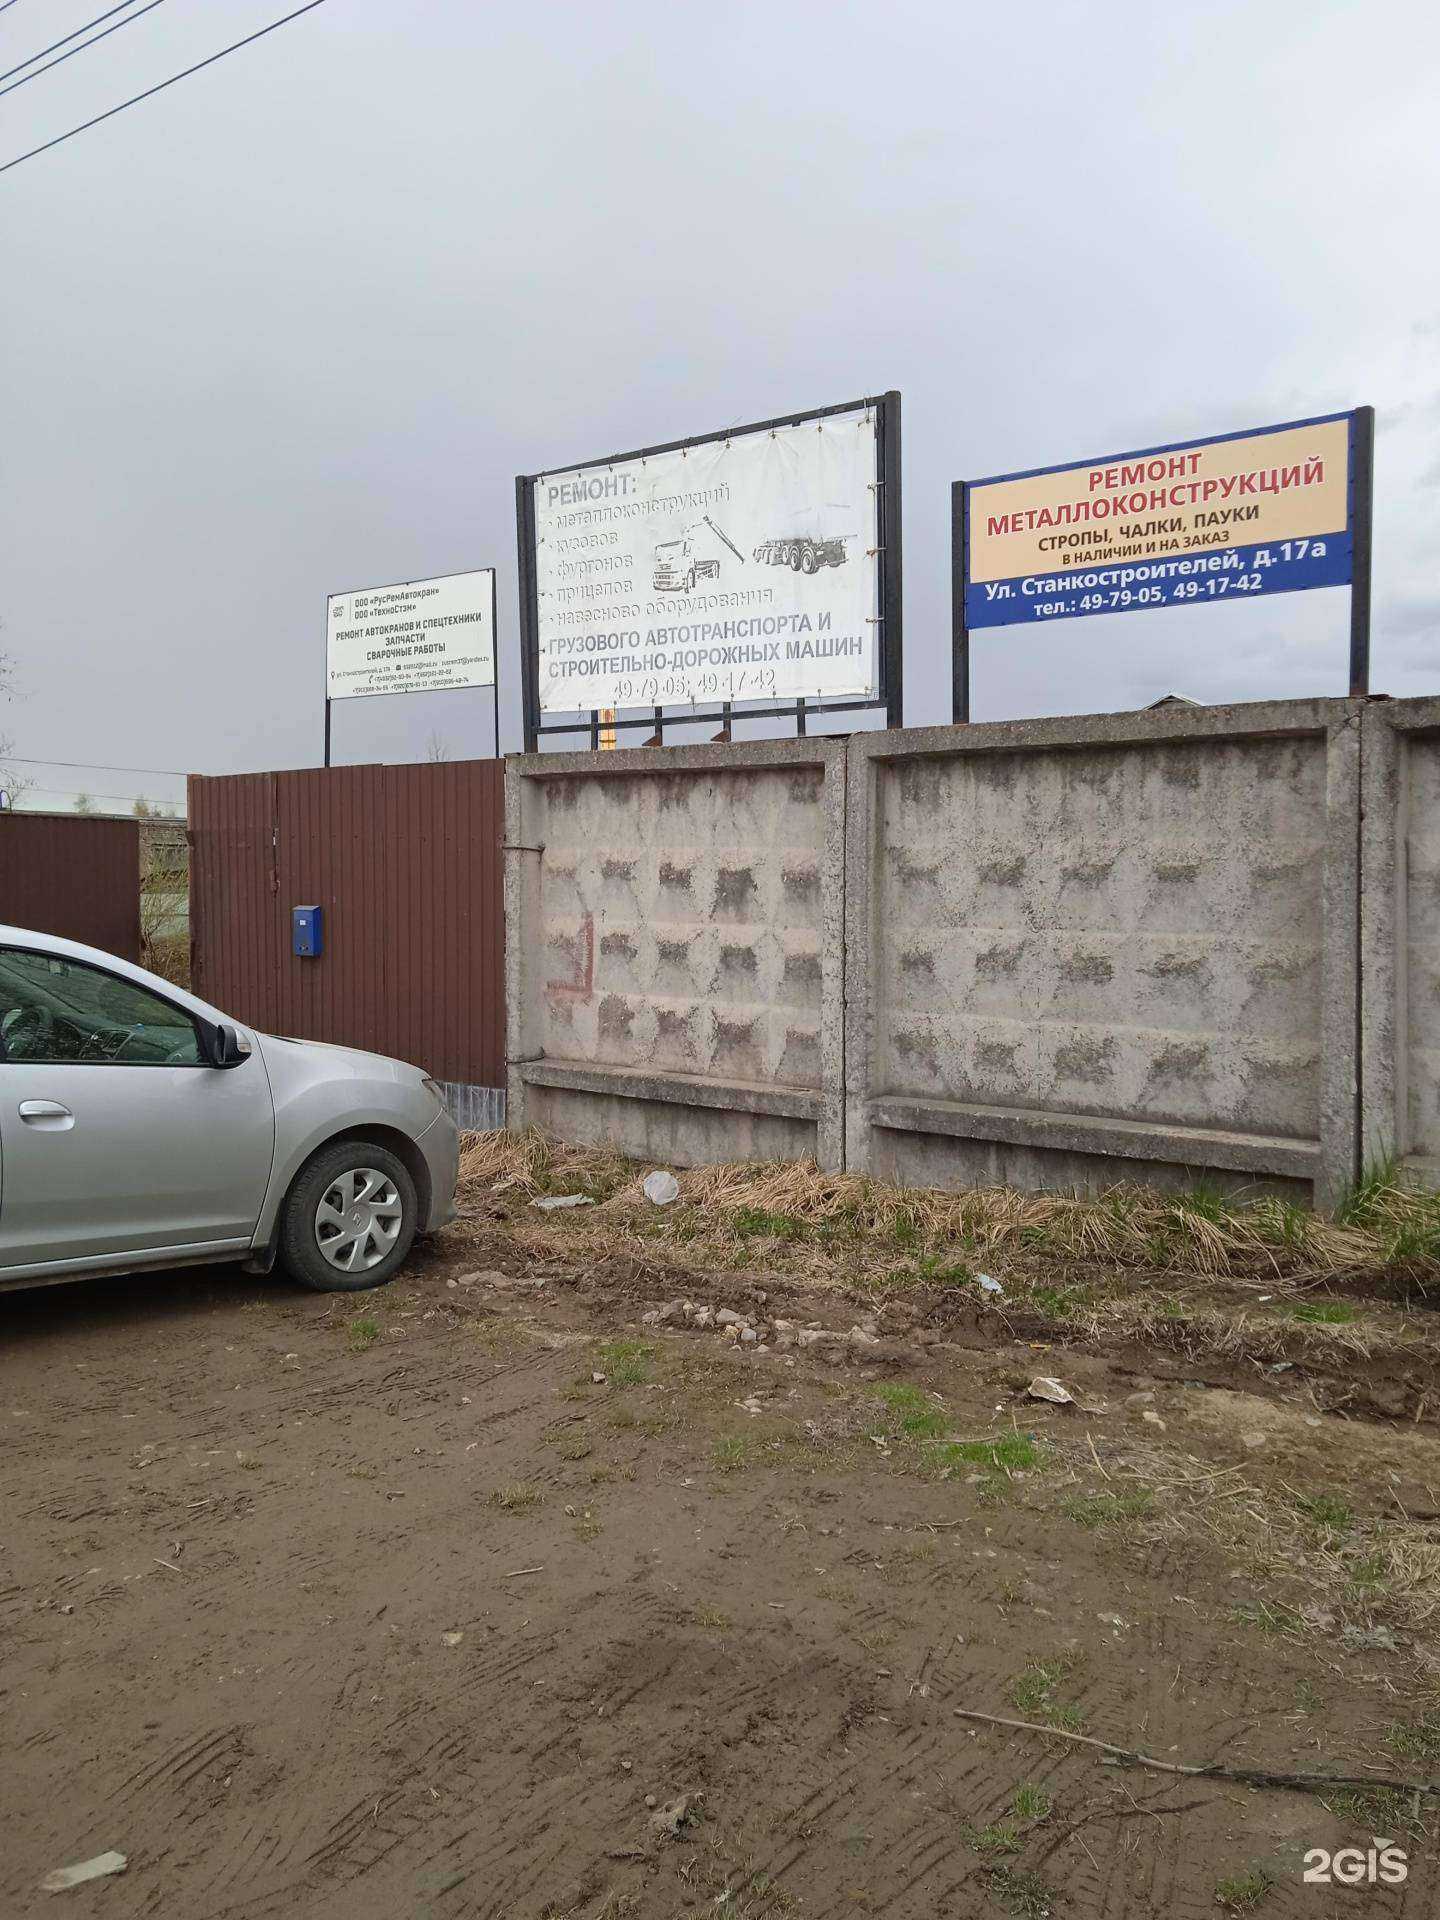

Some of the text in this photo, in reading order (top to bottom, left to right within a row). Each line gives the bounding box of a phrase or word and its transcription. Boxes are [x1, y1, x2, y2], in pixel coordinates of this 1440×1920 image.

[548, 472, 637, 507] РЕМОНТ:
[1089, 453, 1202, 491] РЕМОНТ
[987, 455, 1324, 536] МЕТАЛЛОКОНСТРУКЦИЙ
[1038, 505, 1260, 551] СТРОПЫ, ЧАЛКИ, ПАУКИ
[1062, 531, 1230, 565] В НАЛИЧИИ И НА ЗАКАЗ
[985, 582, 1017, 601] Ул.
[1021, 549, 1246, 597] Станкостроителей,
[354, 598, 369, 608] ООО
[1034, 573, 1263, 616] тел.: 49-79-05, 49-17-42
[336, 612, 482, 641] РЕМОНТ АВТОКРАНОВ И СПЕЦТЕХНИКИ
[354, 610, 369, 619] ООО
[386, 633, 426, 646] ЗАПЧАСТИ
[549, 611, 831, 655] ГРУЗОВОГО АВТОТРАНСПОРТА И
[366, 643, 446, 661] СВАРОЧНЫЕ РАБОТЫ
[549, 636, 864, 679] СТРОИТЕЛЬНО-ДОРОЖНЫХ МАШИН
